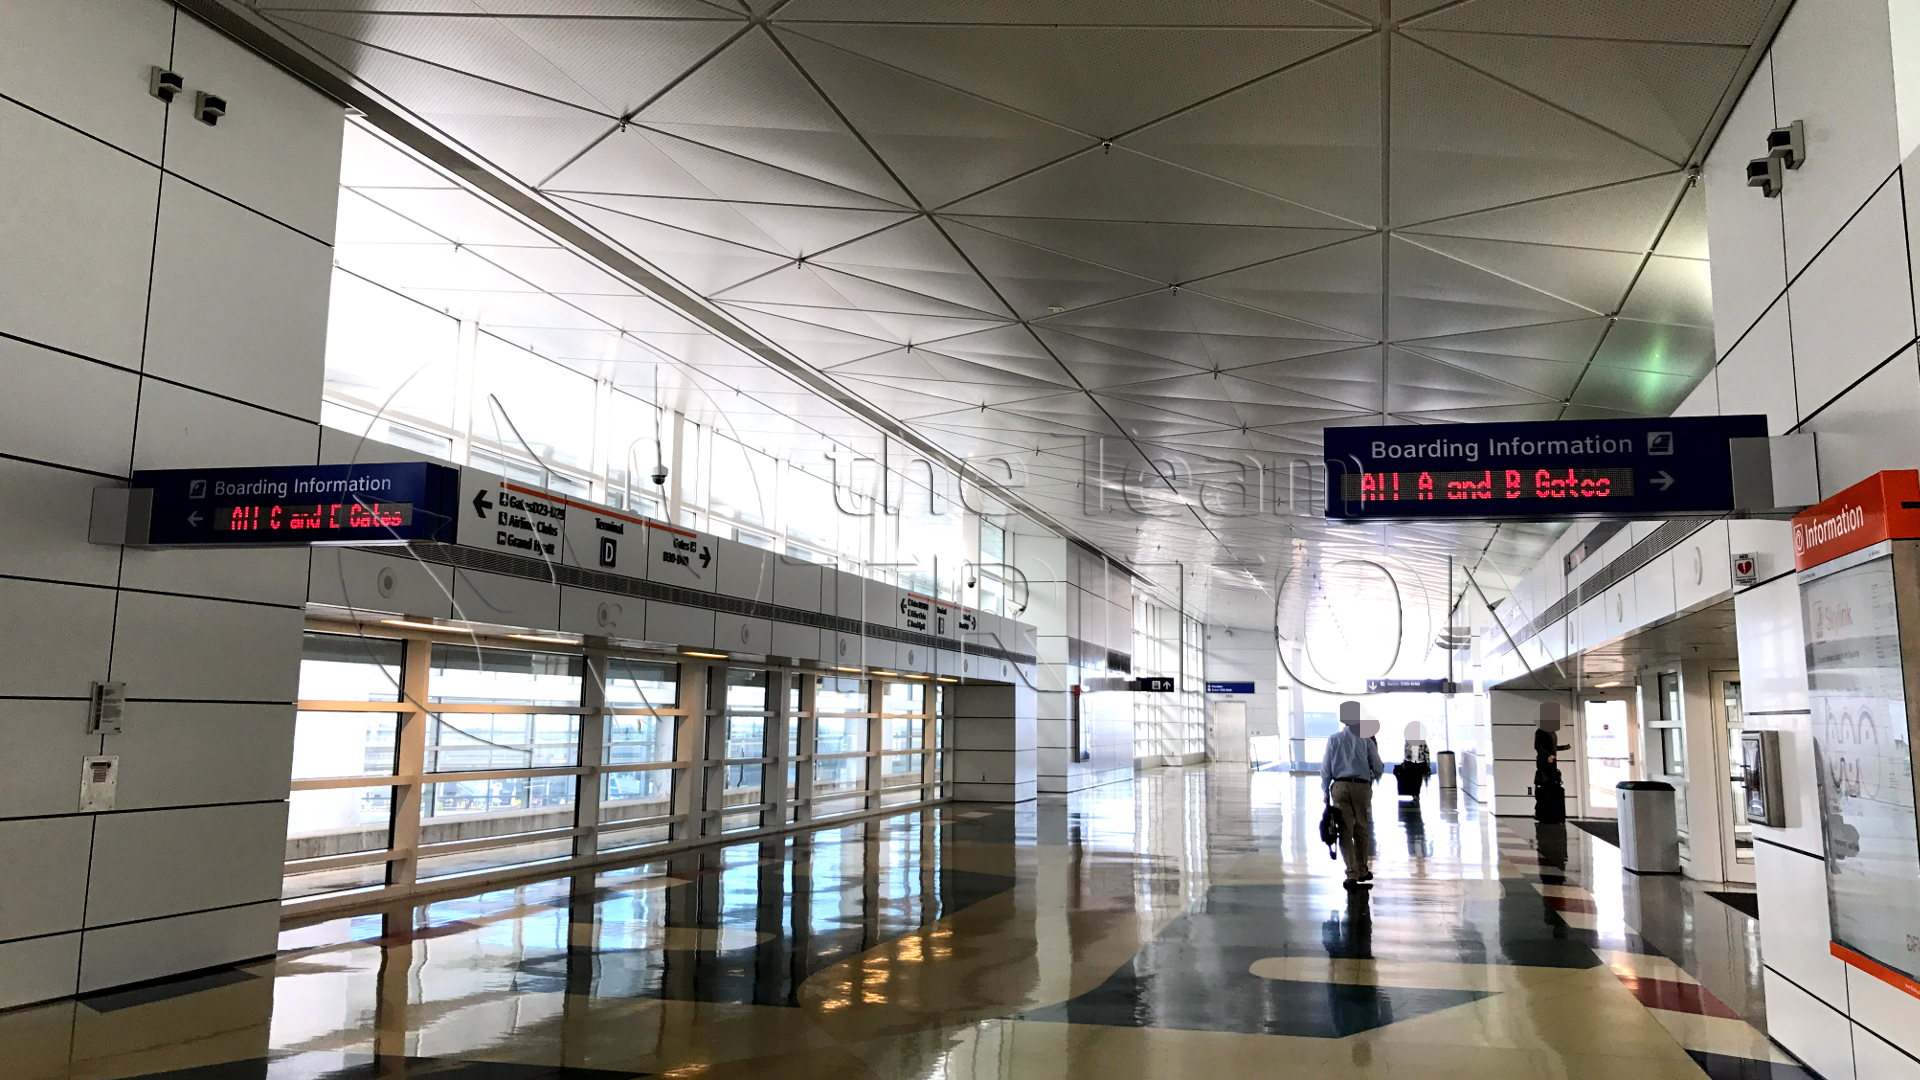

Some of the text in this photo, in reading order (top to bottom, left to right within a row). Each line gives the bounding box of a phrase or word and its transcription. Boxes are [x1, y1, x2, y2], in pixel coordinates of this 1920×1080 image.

[1370, 435, 1633, 462] Boarding Information
[214, 475, 392, 498] Boarding Information
[1362, 468, 1611, 501] All A and B Gates
[230, 505, 260, 531] All
[270, 505, 282, 530] C
[289, 504, 322, 530] and
[350, 502, 403, 528] Gates
[508, 514, 558, 537] Airline Clubs
[595, 517, 625, 536] Terminal
[1804, 503, 1864, 550] Information
[507, 533, 556, 556] Grand Hyatt
[605, 542, 614, 562] D
